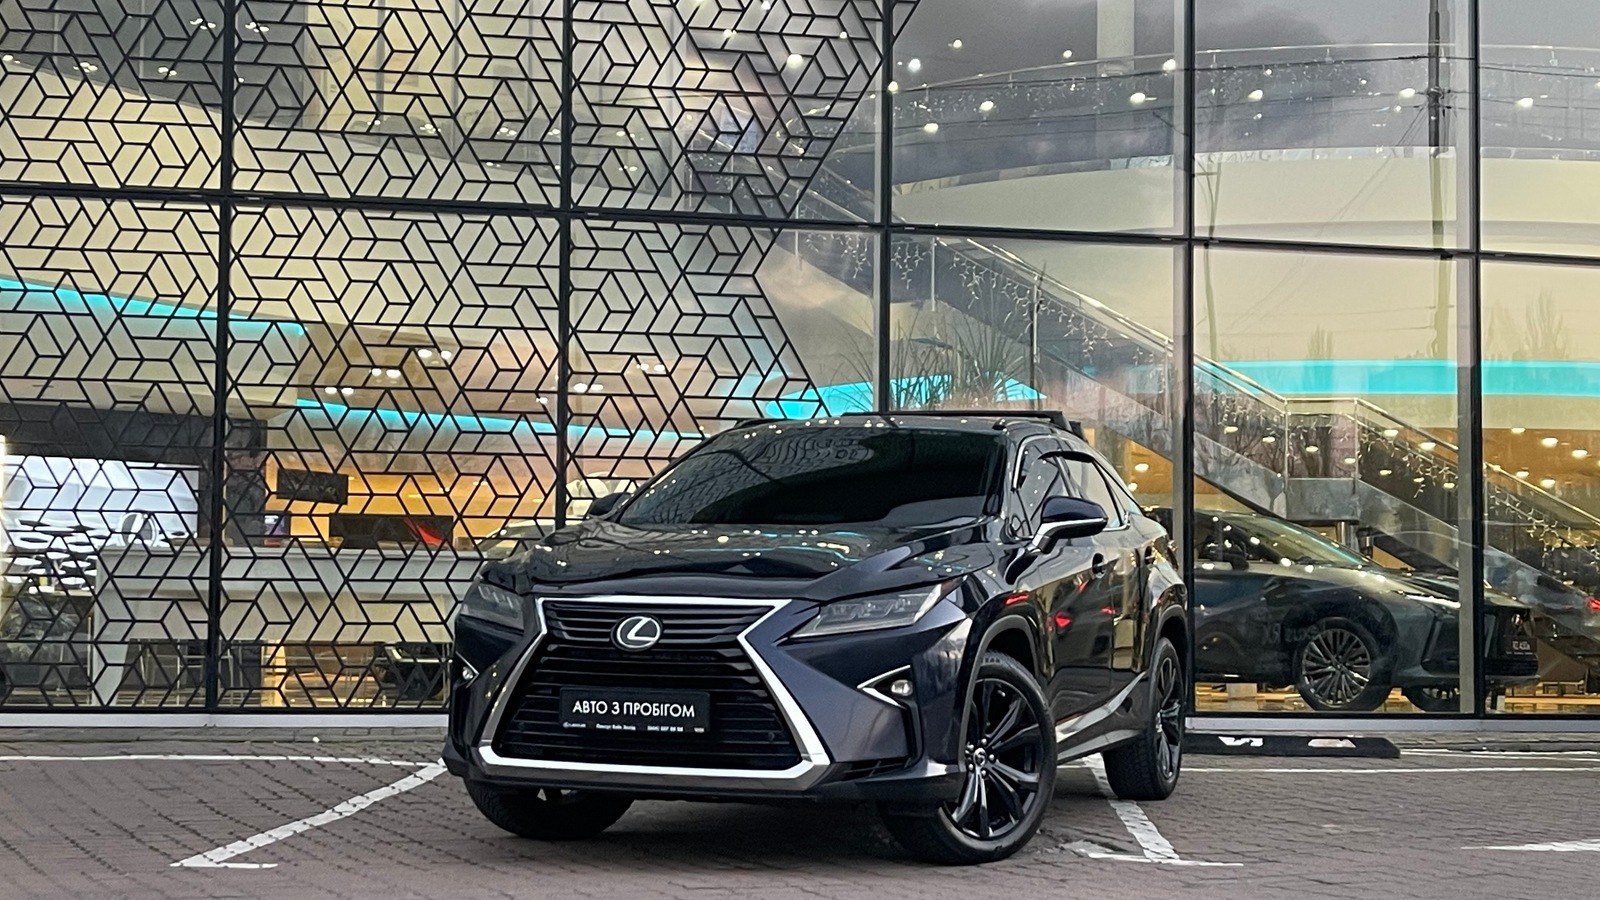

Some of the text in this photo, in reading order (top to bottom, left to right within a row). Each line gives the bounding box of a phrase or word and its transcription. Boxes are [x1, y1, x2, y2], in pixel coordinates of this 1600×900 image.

[572, 700, 695, 717] АВТО З ПРОБІГОМ
